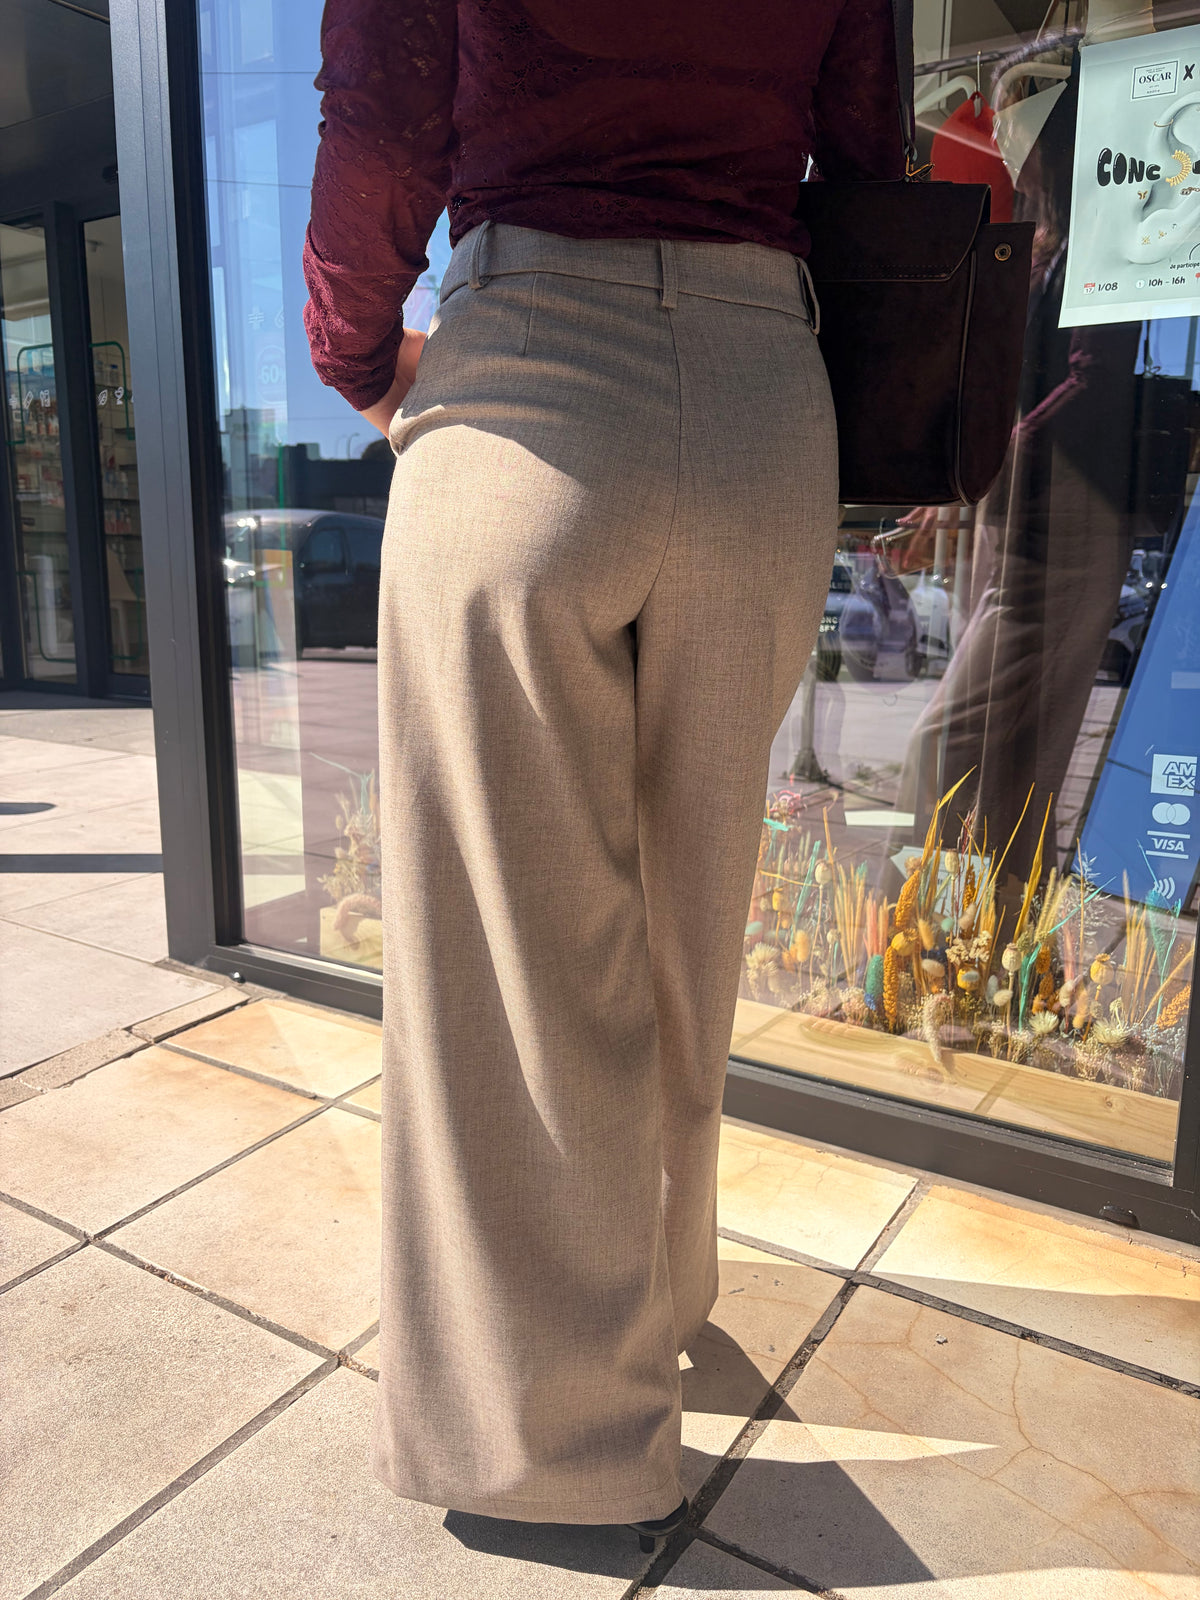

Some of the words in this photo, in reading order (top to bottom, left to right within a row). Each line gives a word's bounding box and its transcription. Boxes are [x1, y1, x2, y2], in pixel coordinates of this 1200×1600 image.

[1139, 71, 1172, 85] OSCAR
[1182, 63, 1195, 81] X
[1148, 278, 1163, 287] 10h
[1171, 276, 1186, 285] 16h
[1164, 762, 1197, 777] AM
[1166, 775, 1196, 790] EX
[1151, 838, 1185, 852] VISA
